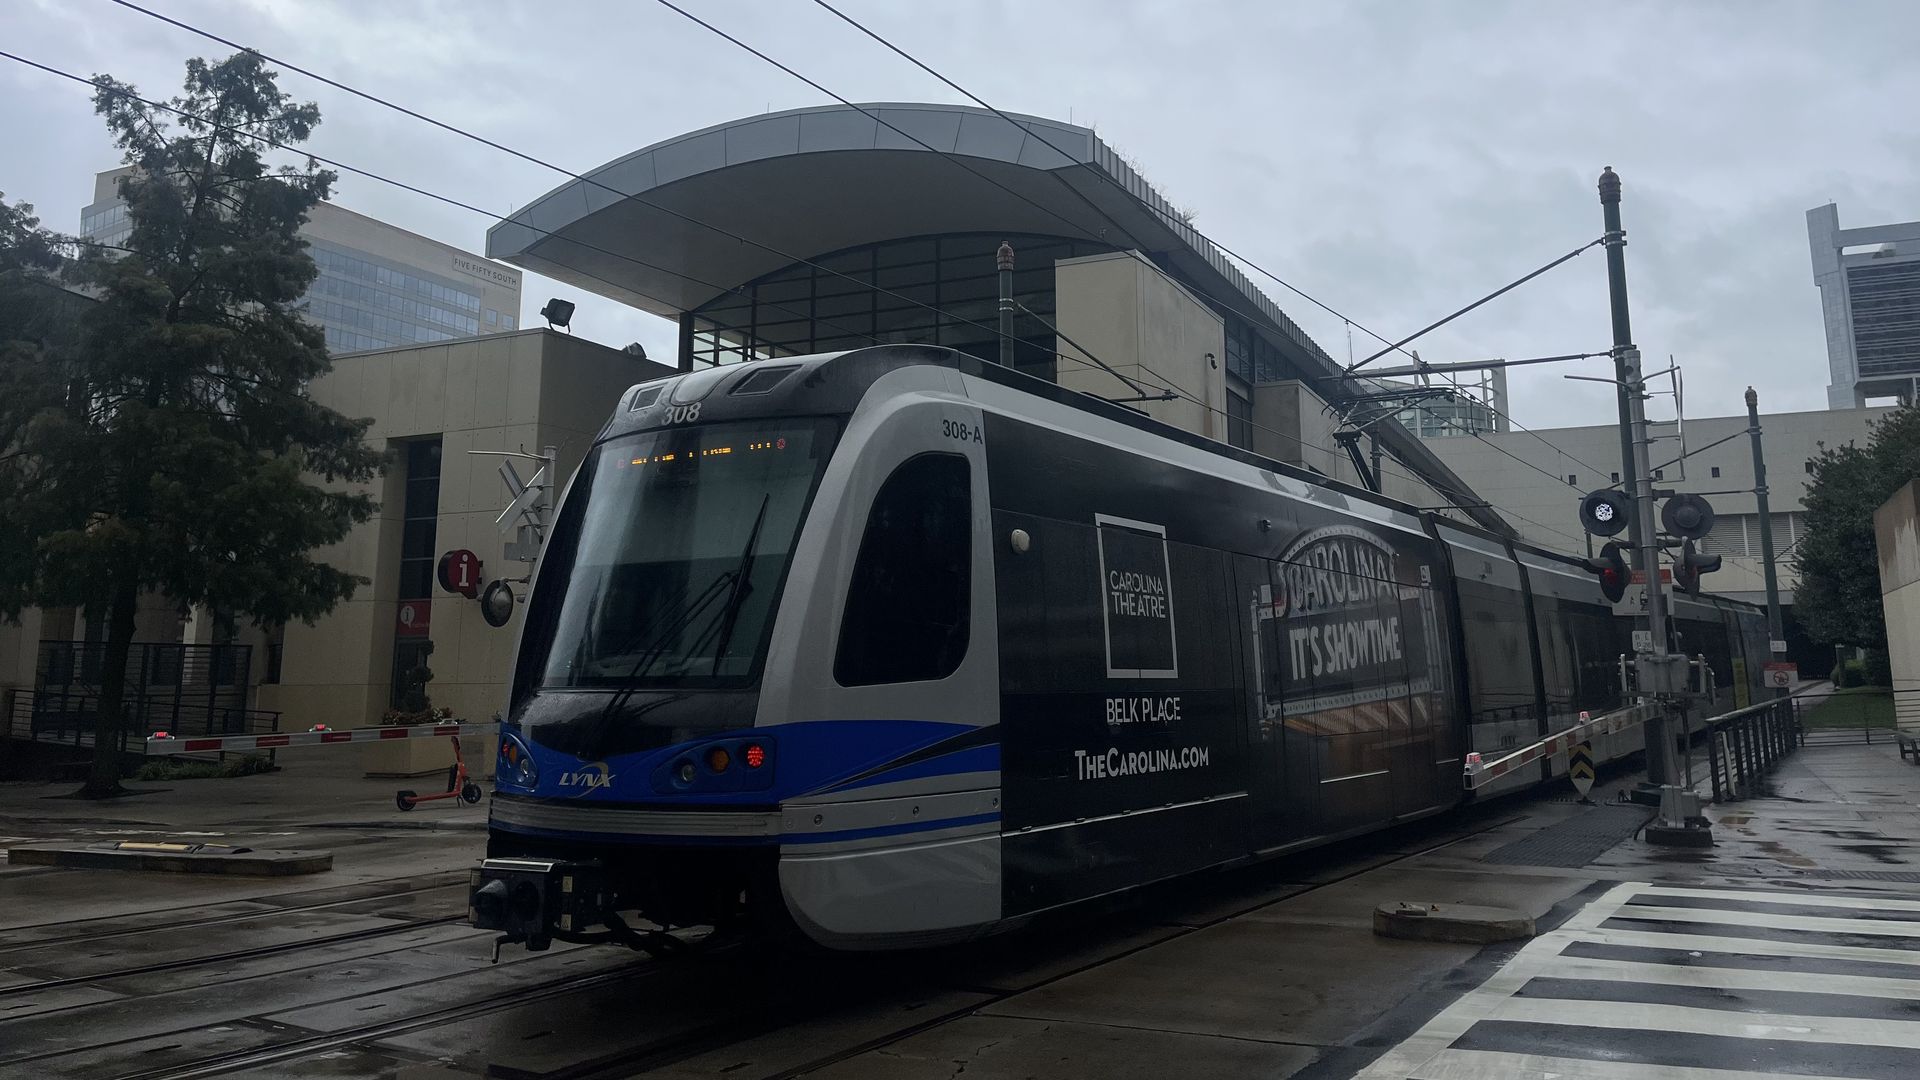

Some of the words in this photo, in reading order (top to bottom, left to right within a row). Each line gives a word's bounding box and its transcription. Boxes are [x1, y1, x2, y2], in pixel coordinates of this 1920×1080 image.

[454, 258, 470, 270] FIVE
[472, 265, 491, 277] FIFTY
[493, 271, 517, 286] SOUTH
[662, 402, 702, 425] 308
[942, 419, 983, 445] 308-A
[1109, 570, 1165, 595] CAROLINA
[1111, 592, 1166, 619] THEATRE
[1289, 626, 1323, 680] IT'S
[1323, 616, 1402, 674] SHOWTIME
[1106, 697, 1139, 723] BELK
[1141, 697, 1181, 722] PLACE
[558, 772, 616, 788] LYNX
